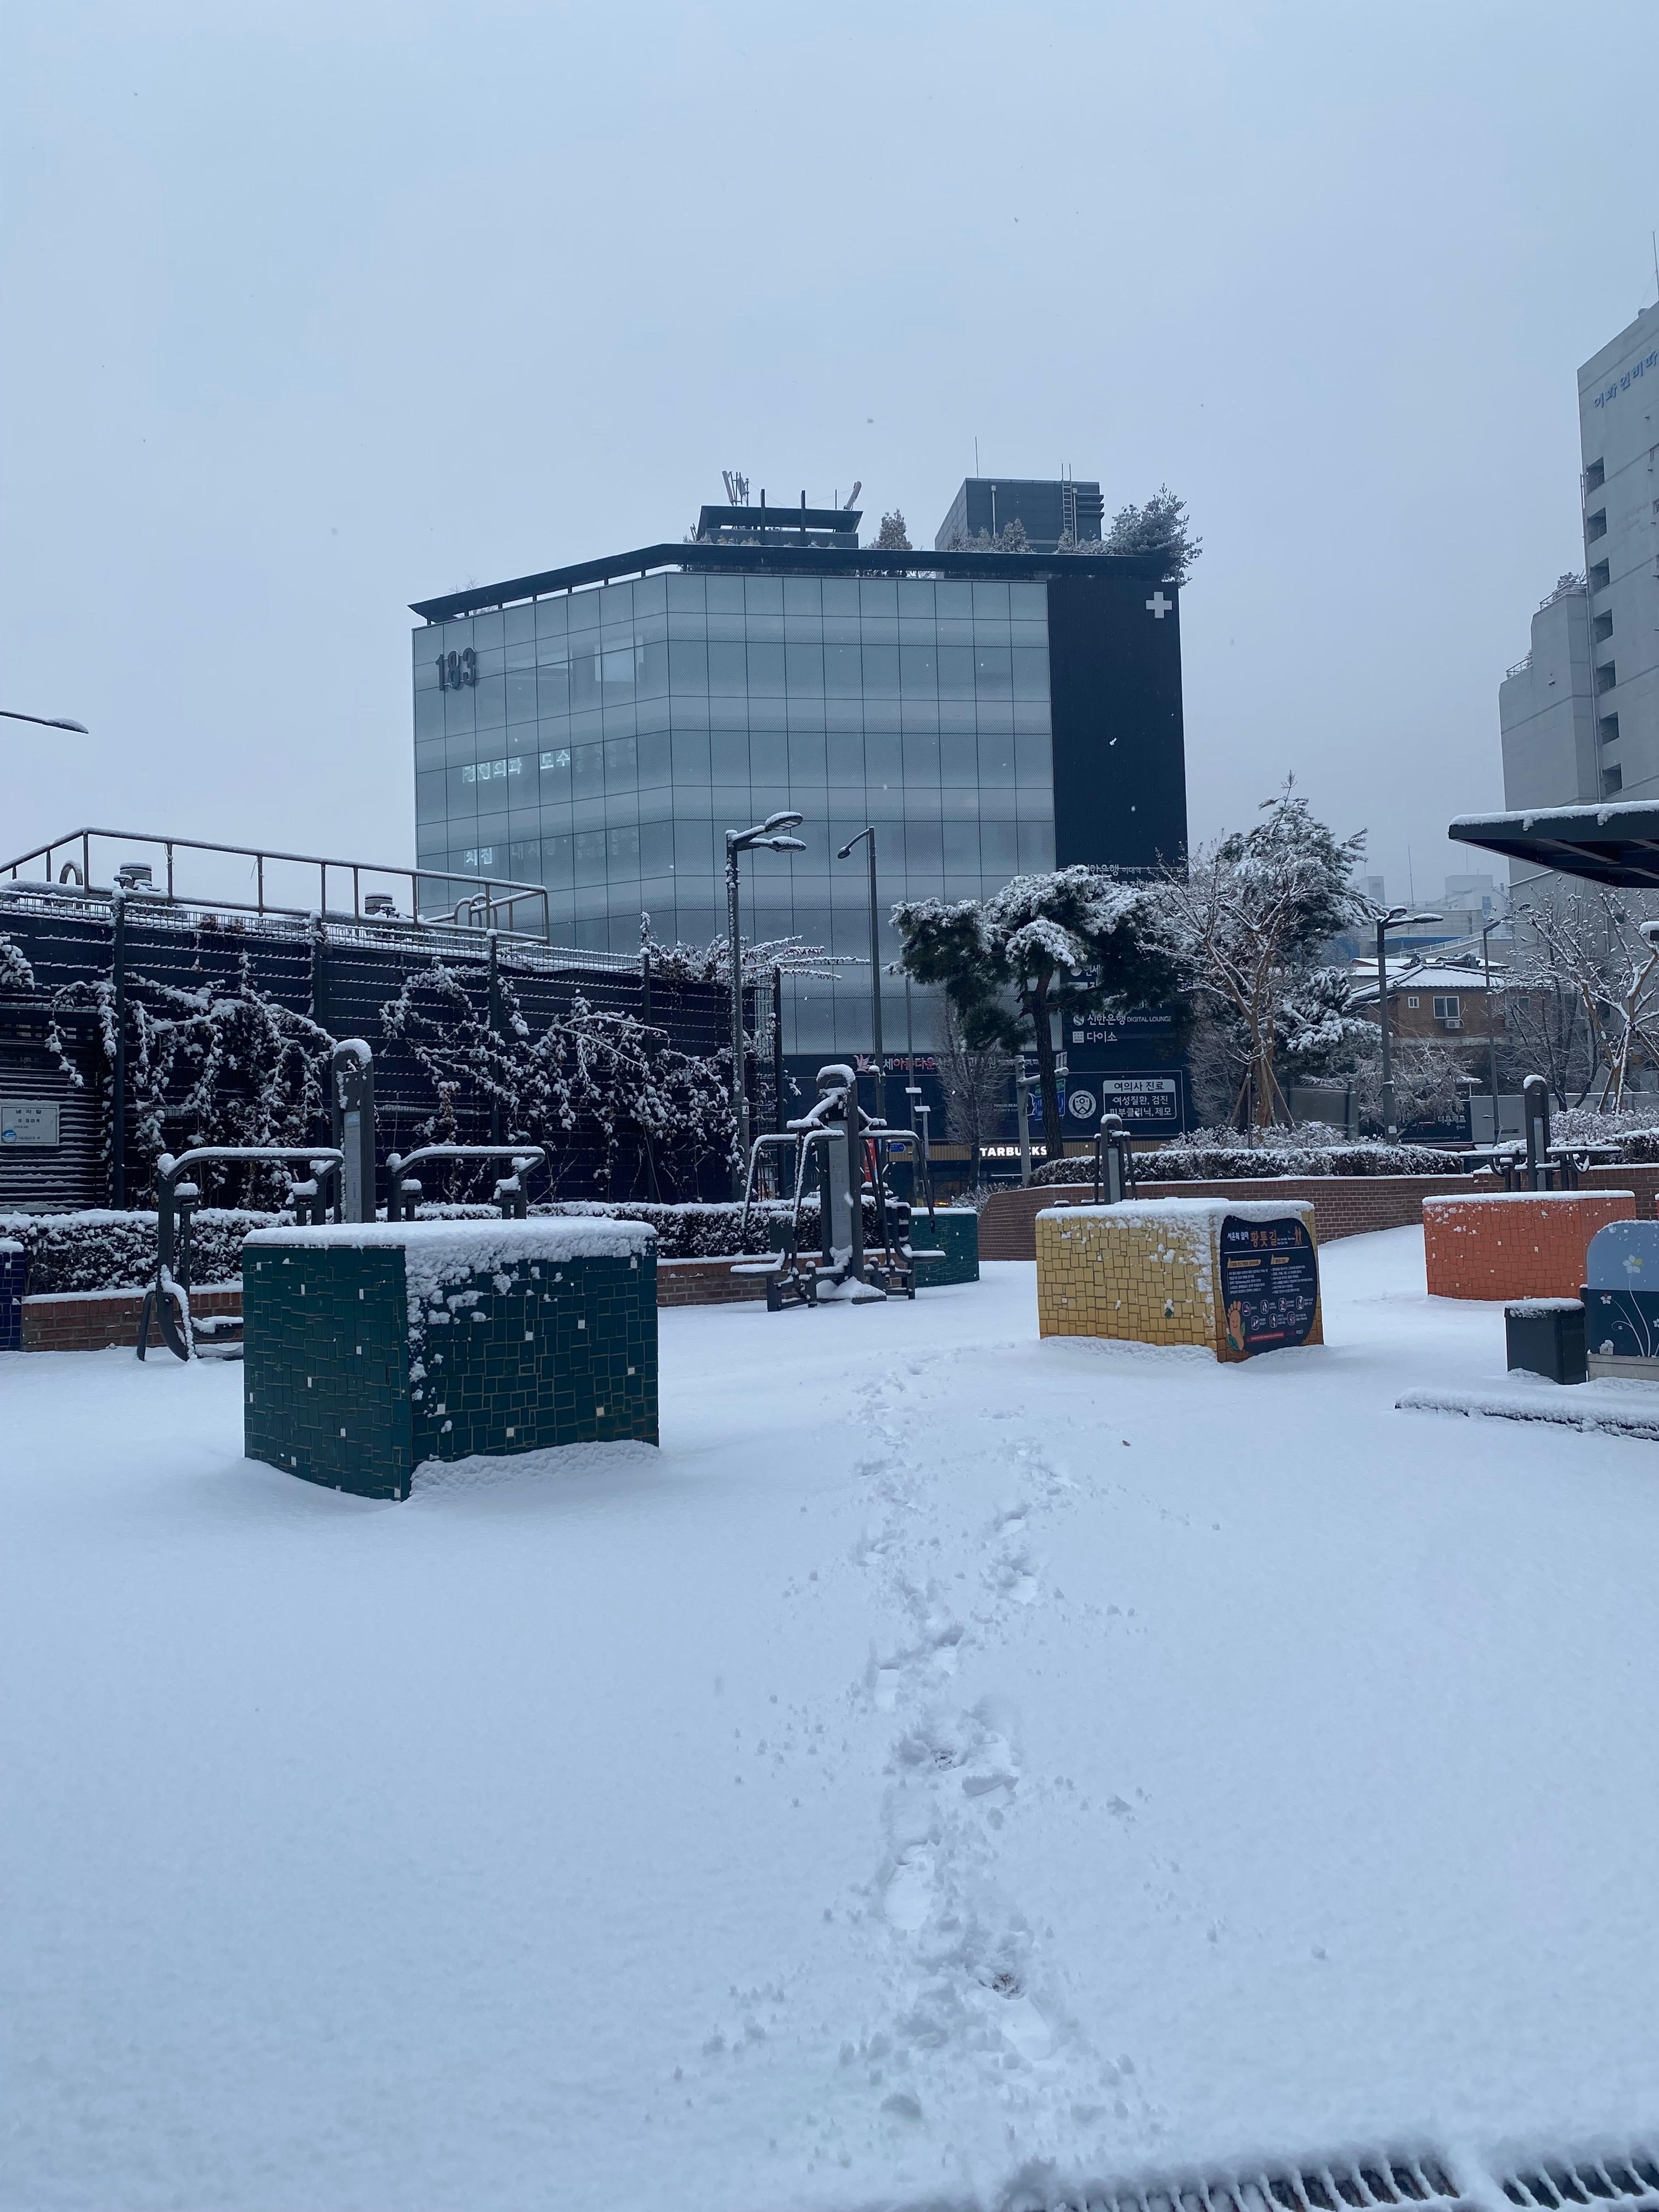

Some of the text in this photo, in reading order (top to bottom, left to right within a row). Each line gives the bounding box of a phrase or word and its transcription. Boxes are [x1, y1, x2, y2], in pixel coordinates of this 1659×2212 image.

[435, 647, 476, 691] 183
[1087, 1014, 1126, 1025] 신한은행
[1086, 1031, 1118, 1043] 다이소
[1114, 1081, 1165, 1092] 여의사 진료
[1152, 1095, 1168, 1105] 검진
